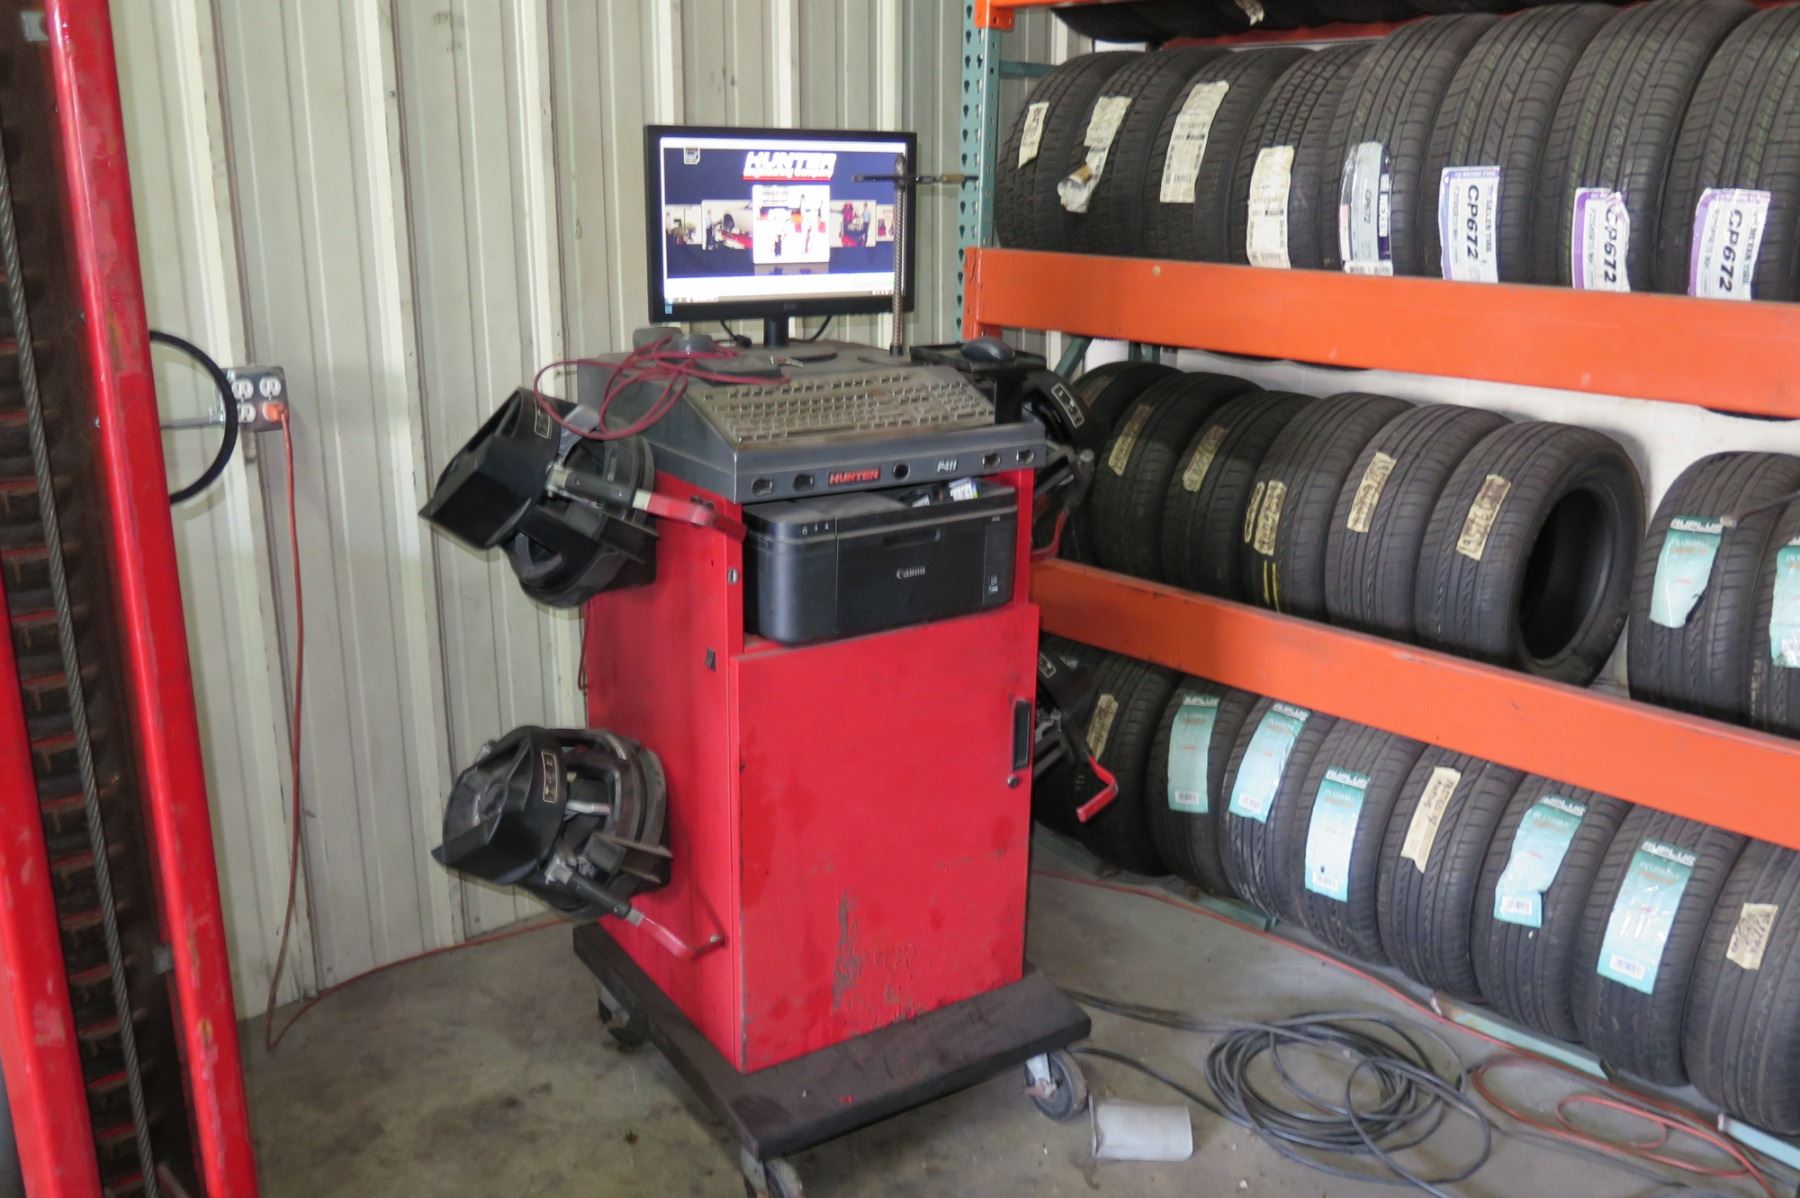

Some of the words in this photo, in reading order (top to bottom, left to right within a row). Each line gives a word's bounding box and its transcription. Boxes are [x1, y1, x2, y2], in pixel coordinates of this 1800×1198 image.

[1466, 184, 1480, 261] CP672
[1603, 207, 1618, 284] CP672
[1718, 209, 1743, 292] CP672
[829, 469, 880, 485] HUNTER
[896, 566, 925, 580] Canon
